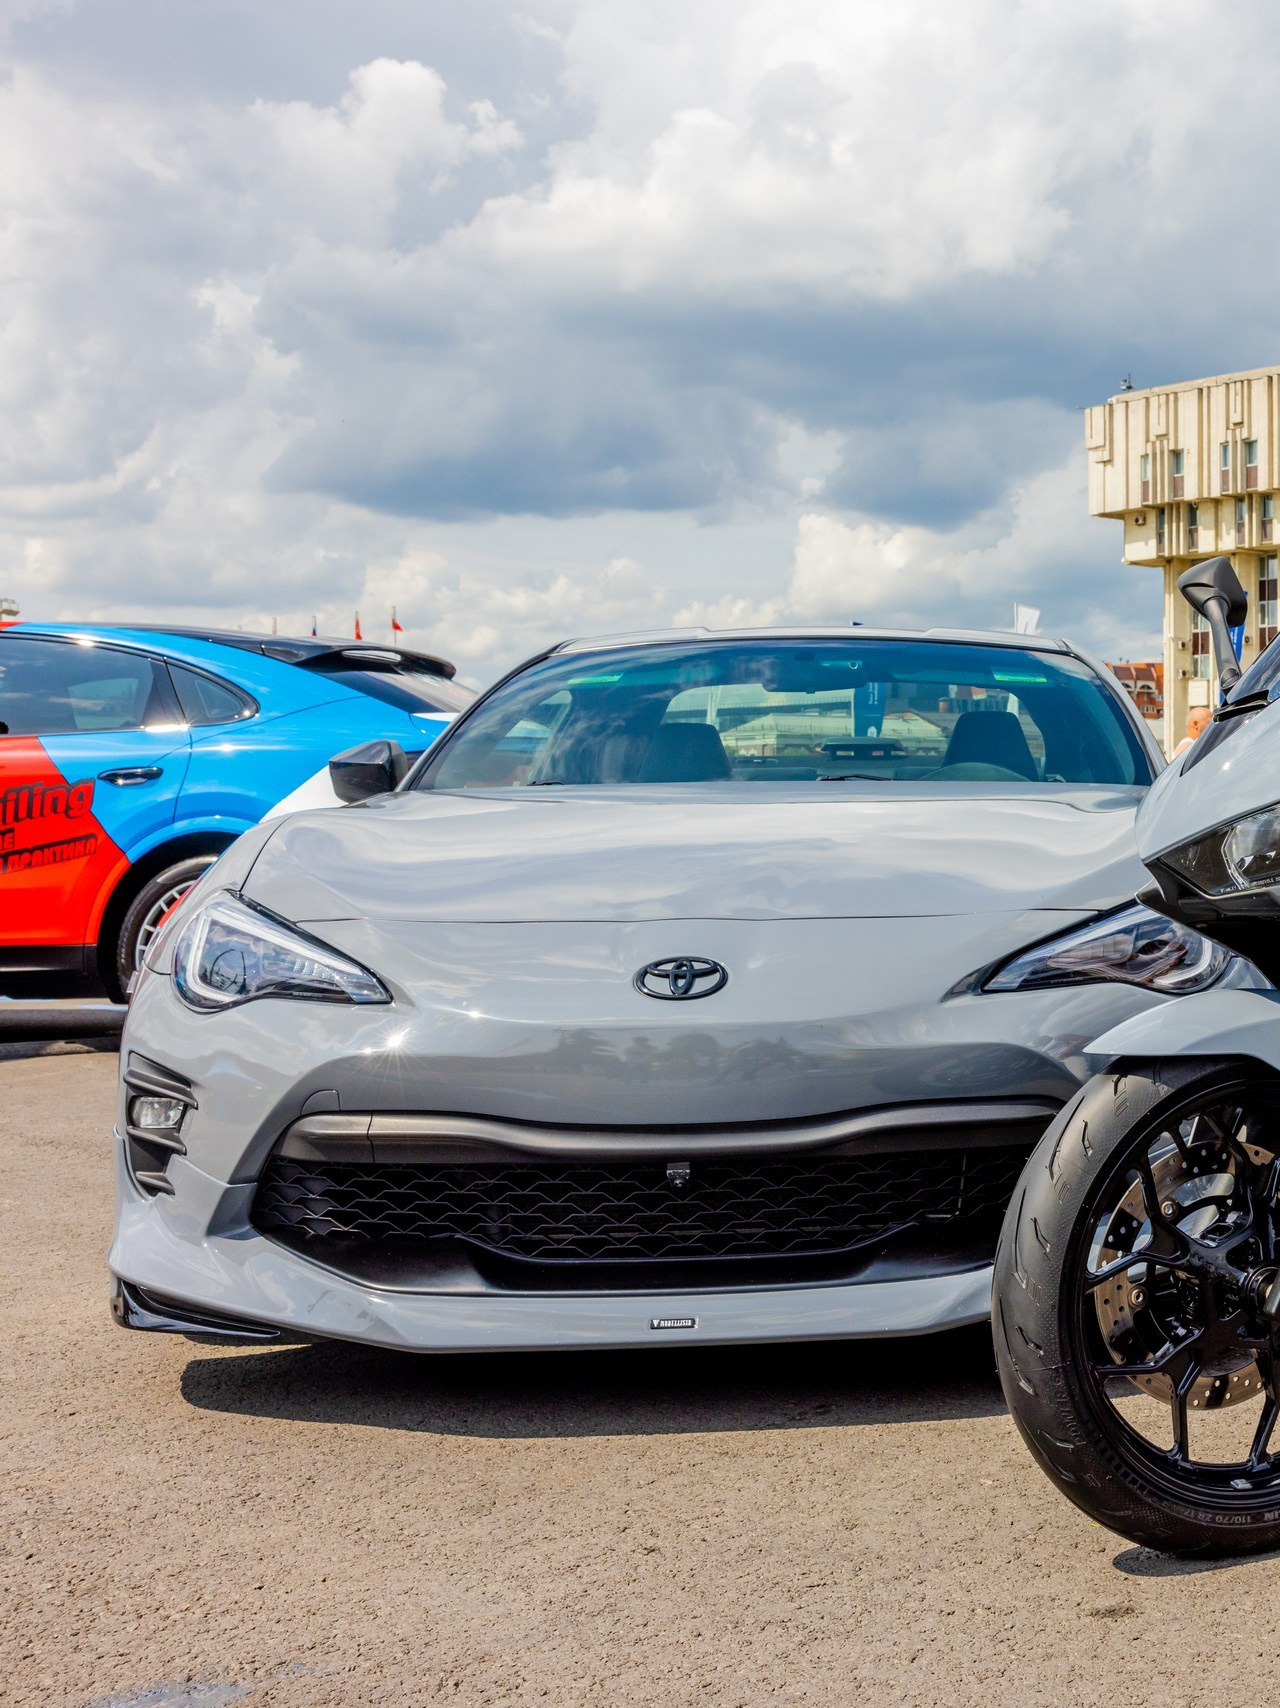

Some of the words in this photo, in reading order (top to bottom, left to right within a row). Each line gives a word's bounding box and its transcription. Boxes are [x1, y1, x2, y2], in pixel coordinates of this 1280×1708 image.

[0, 778, 96, 825] iling
[1198, 1512, 1213, 1522] ZR
[1215, 1514, 1252, 1525] 110/70
